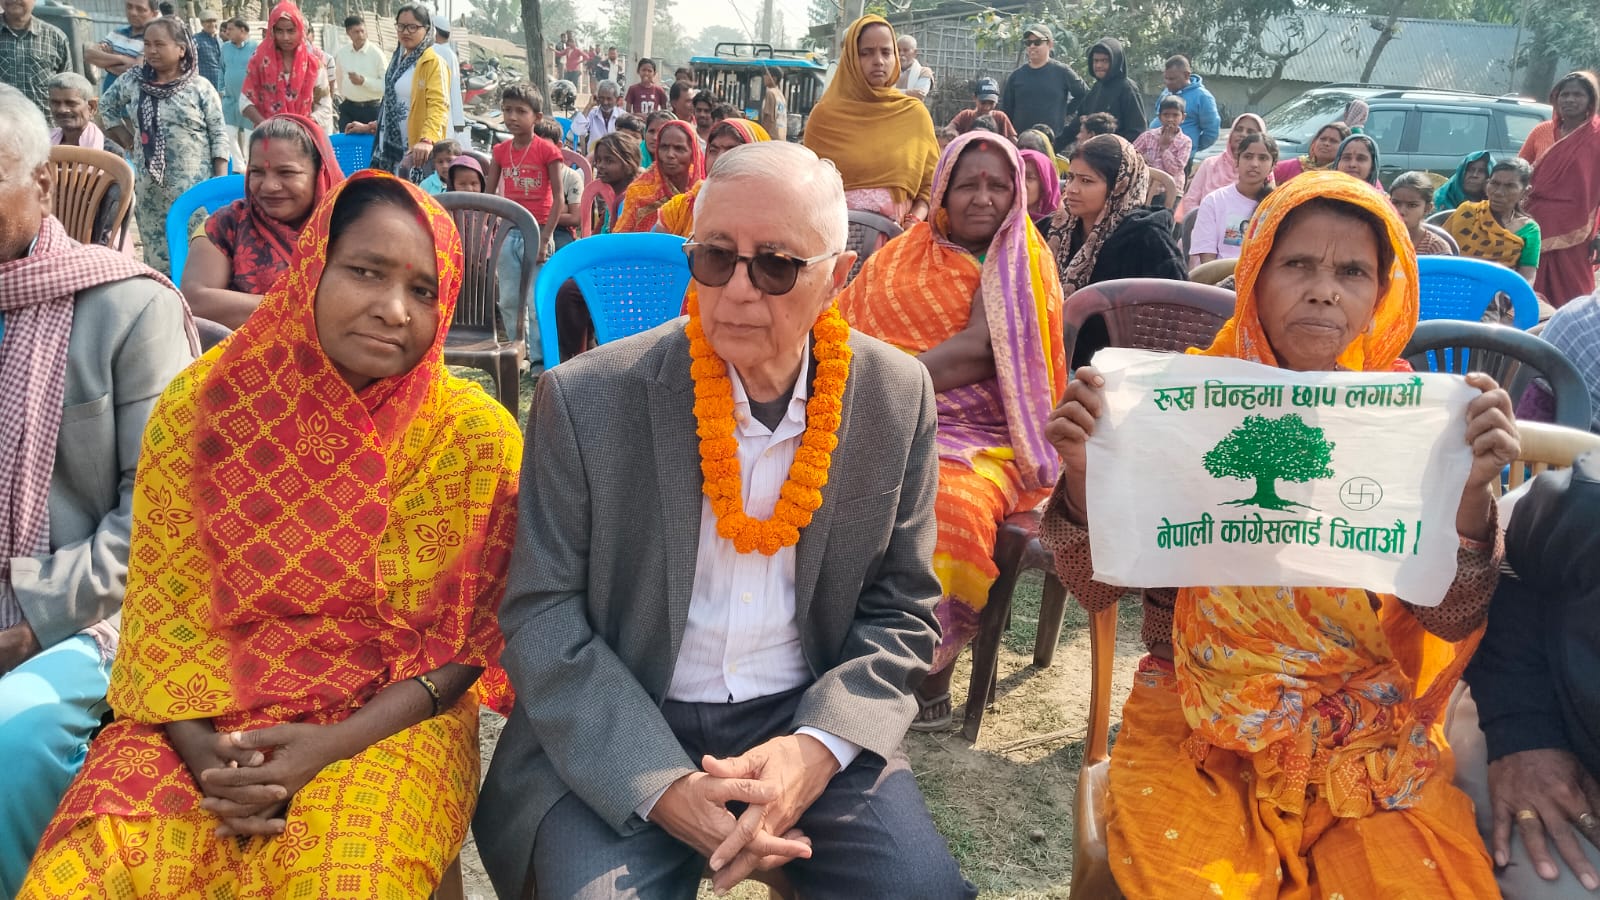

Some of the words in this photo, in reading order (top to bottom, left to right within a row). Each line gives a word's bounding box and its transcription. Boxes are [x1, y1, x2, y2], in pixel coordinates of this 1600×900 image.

[1204, 380, 1285, 410] चिन्हमा
[1291, 385, 1336, 408] छाप
[1157, 512, 1215, 549] नेपाली
[1220, 512, 1323, 546] कांग्रेसलाई
